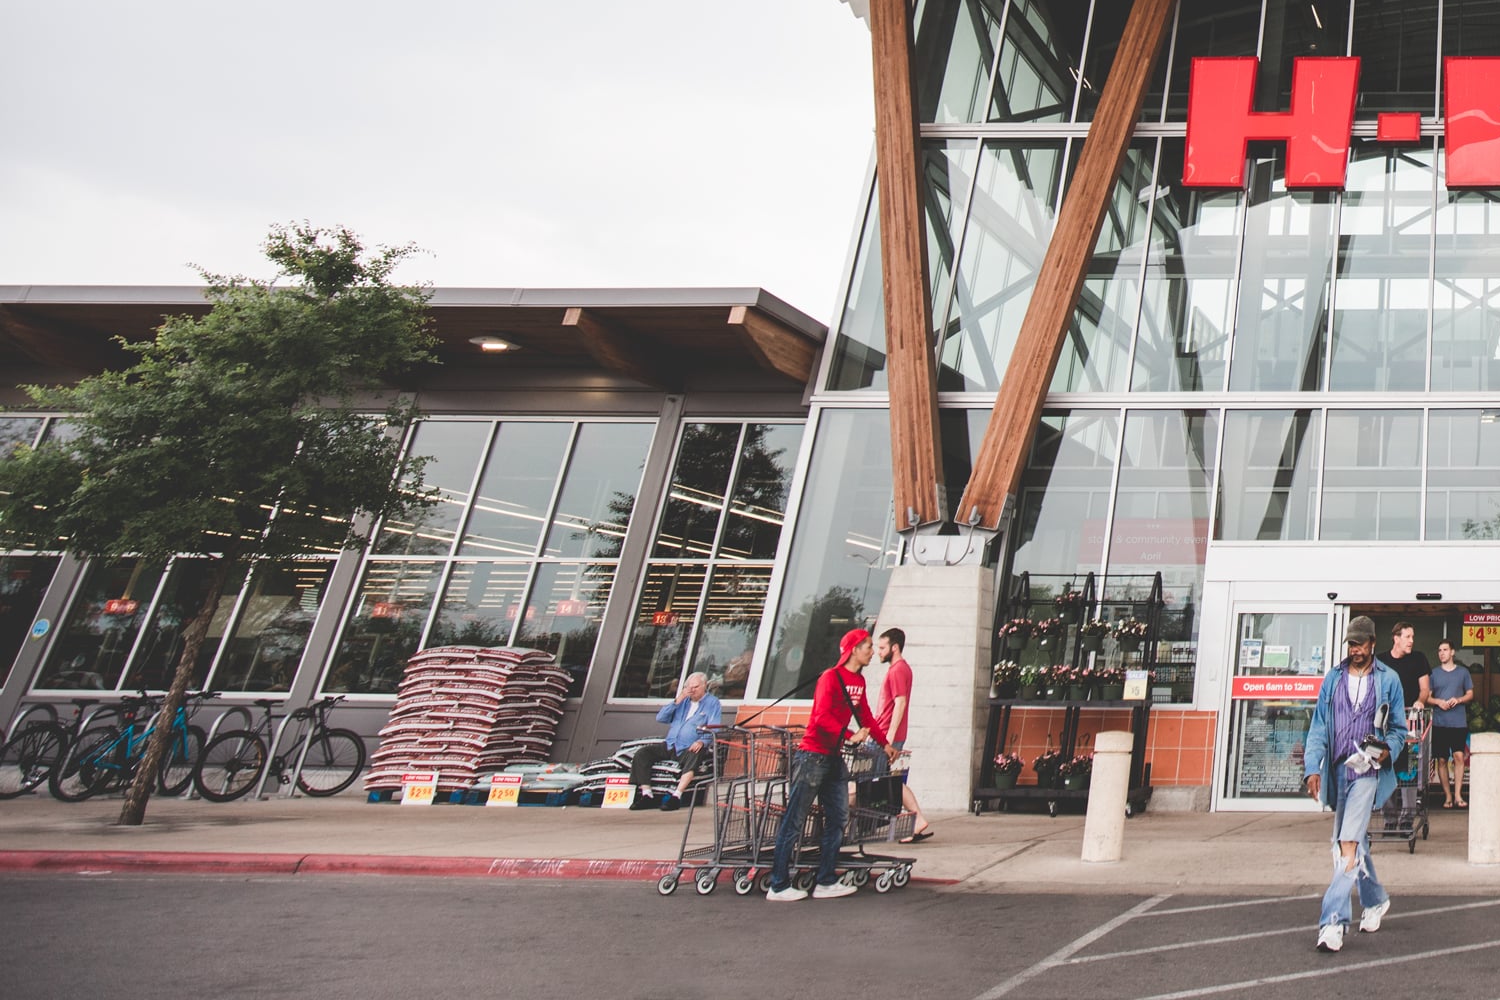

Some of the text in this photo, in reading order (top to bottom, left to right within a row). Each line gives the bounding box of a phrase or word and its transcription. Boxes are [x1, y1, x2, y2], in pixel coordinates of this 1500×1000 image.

[1126, 533, 1181, 547] community
[1140, 550, 1162, 562] April
[1243, 682, 1315, 692] Open 6am to 12am
[488, 859, 525, 874] FIRE
[527, 859, 570, 875] ZONE
